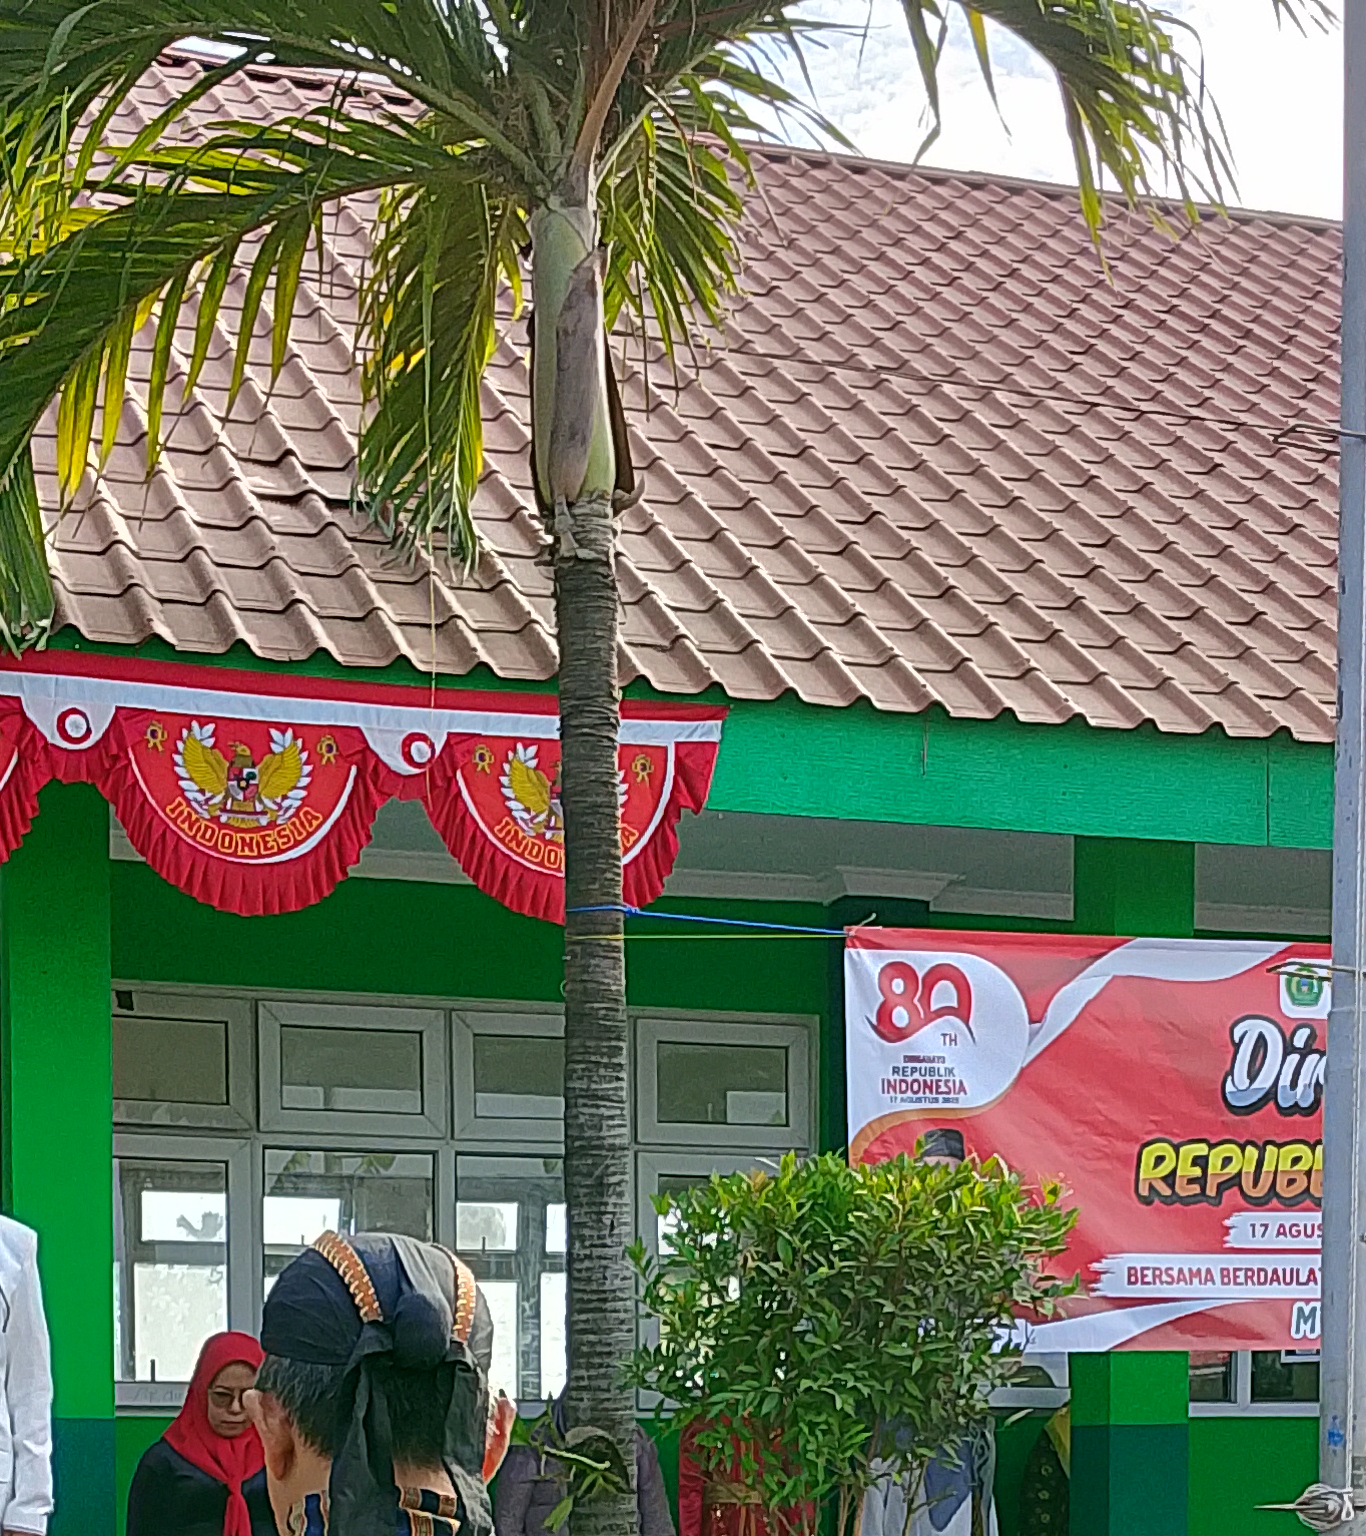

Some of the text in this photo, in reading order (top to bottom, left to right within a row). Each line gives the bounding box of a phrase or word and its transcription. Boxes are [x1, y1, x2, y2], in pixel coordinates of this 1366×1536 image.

[166, 797, 323, 856] INDONESIA
[494, 817, 639, 870] INDOA
[876, 961, 973, 1043] 80
[941, 1033, 957, 1046] TH
[892, 1066, 955, 1077] REPUBLIK
[881, 1078, 967, 1095] INDONESIA
[1250, 1223, 1269, 1239] 17
[1275, 1223, 1323, 1239] AGUS
[1127, 1266, 1216, 1287] BERSAMA
[1220, 1267, 1322, 1287] BERDAULA
